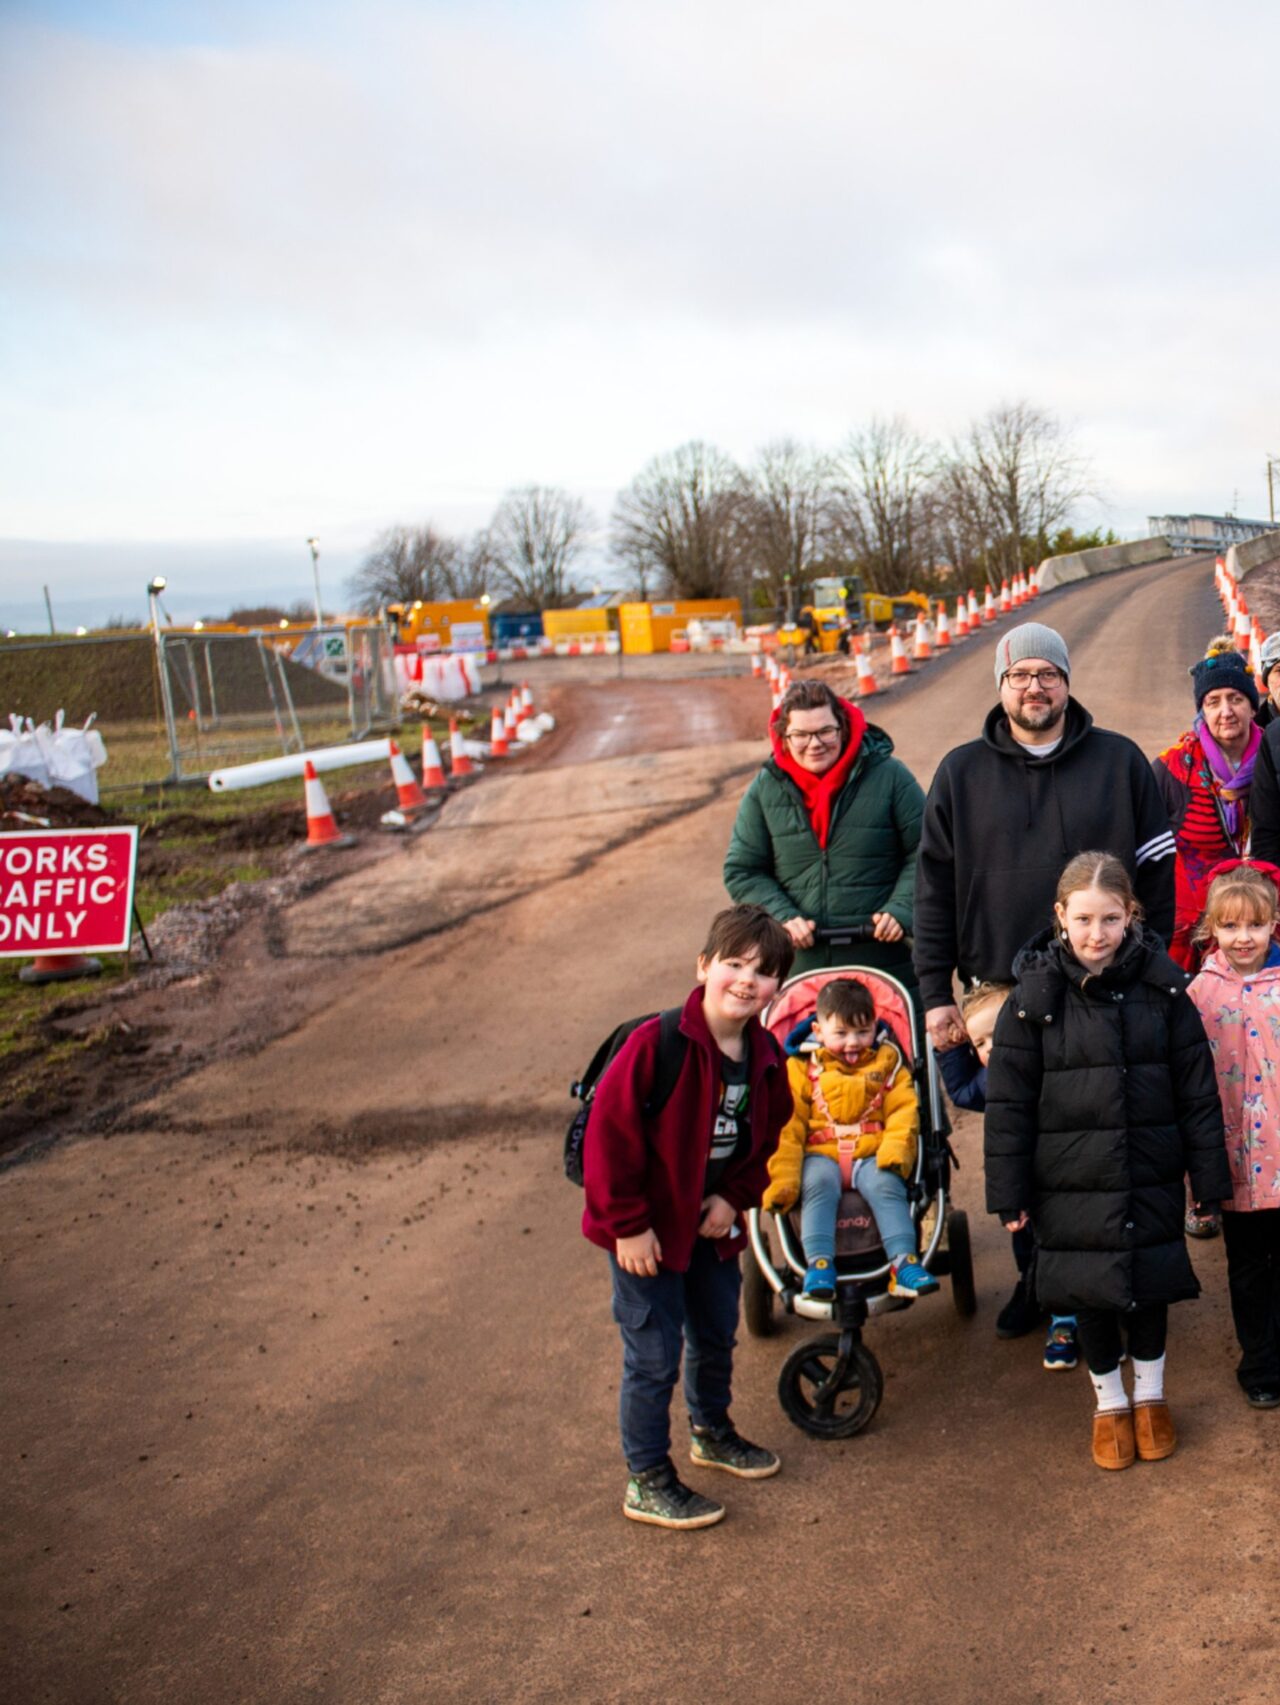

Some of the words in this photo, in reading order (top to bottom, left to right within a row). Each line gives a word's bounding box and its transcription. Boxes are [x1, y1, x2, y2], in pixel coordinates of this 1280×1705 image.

[0, 843, 108, 875] ORKS
[0, 876, 116, 908] AFFIC
[836, 1215, 871, 1229] andy
